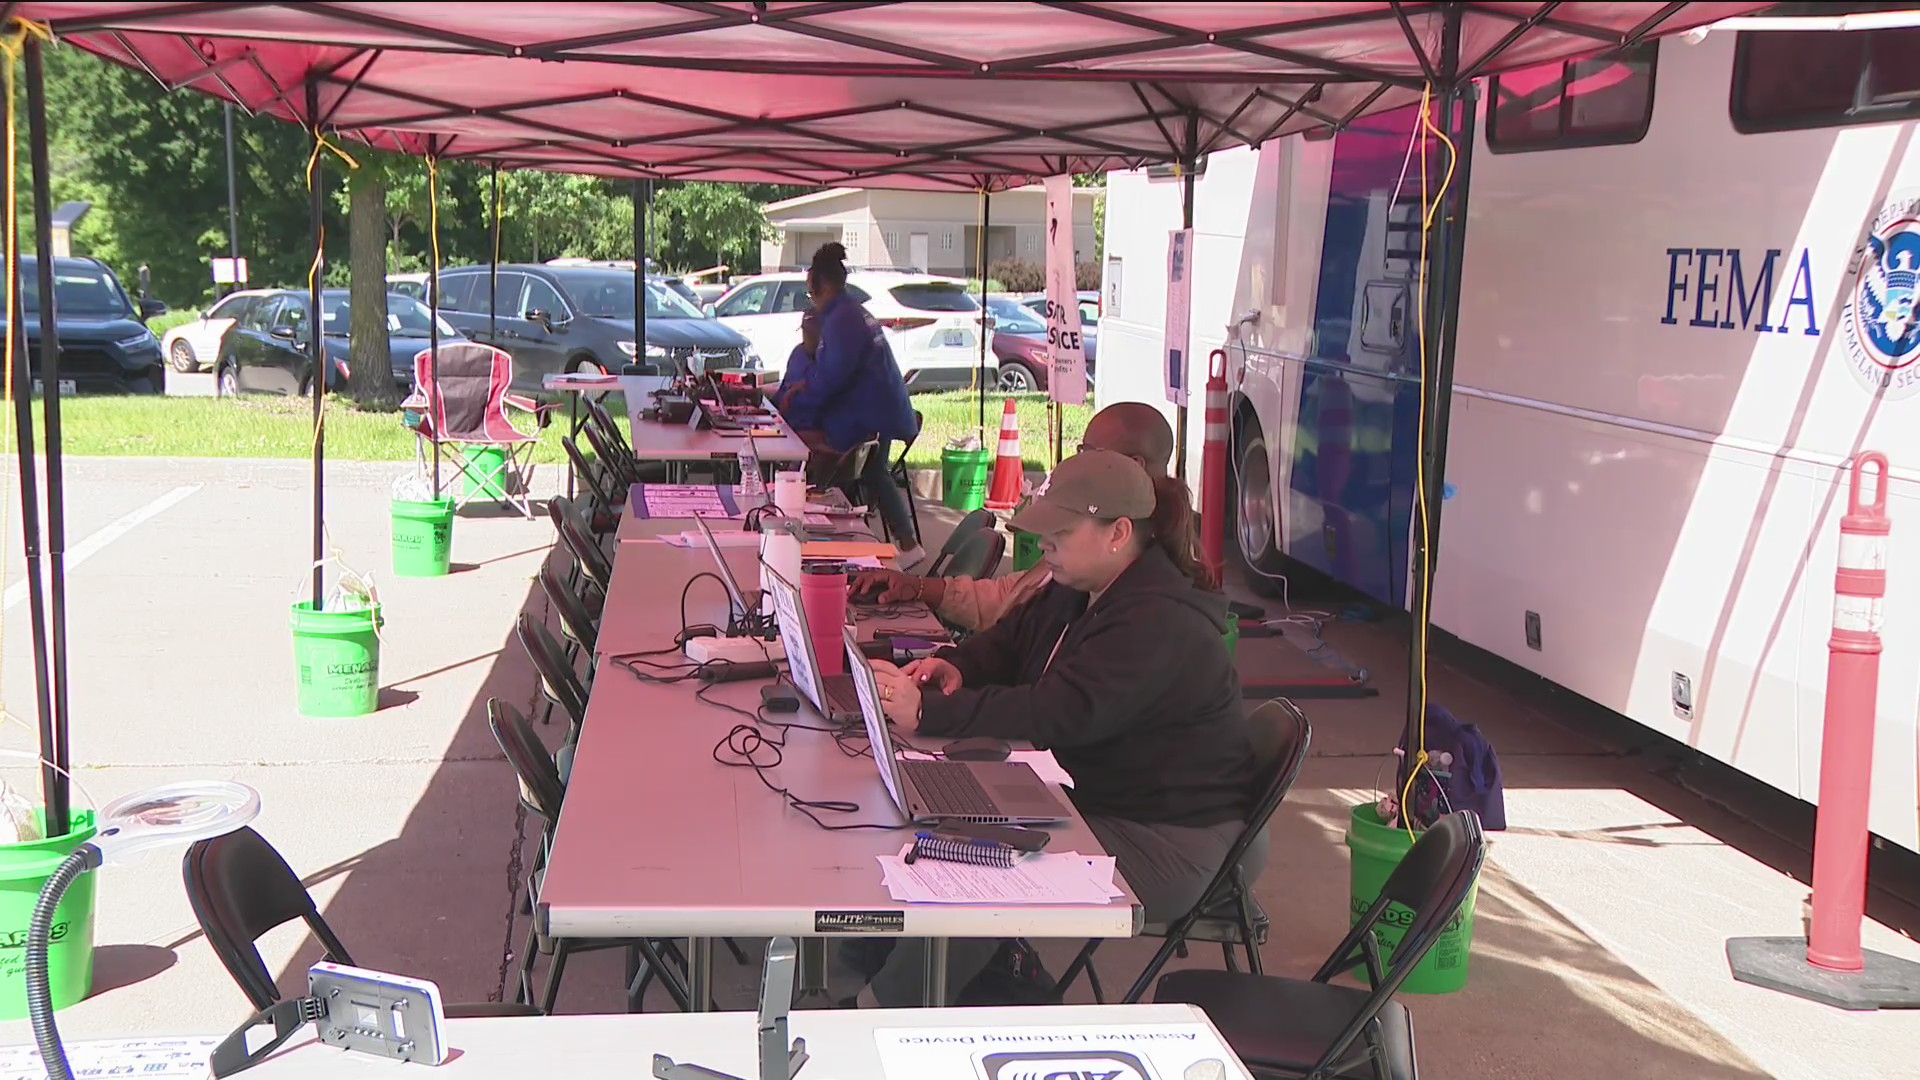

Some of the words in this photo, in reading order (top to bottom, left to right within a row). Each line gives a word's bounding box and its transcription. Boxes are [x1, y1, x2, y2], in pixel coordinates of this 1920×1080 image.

[1660, 248, 1821, 336] FEMA
[1843, 303, 1891, 388] HOMELAND
[899, 1036, 976, 1044] Device
[982, 1034, 1088, 1042] Listening
[1095, 1033, 1196, 1041] Assistive
